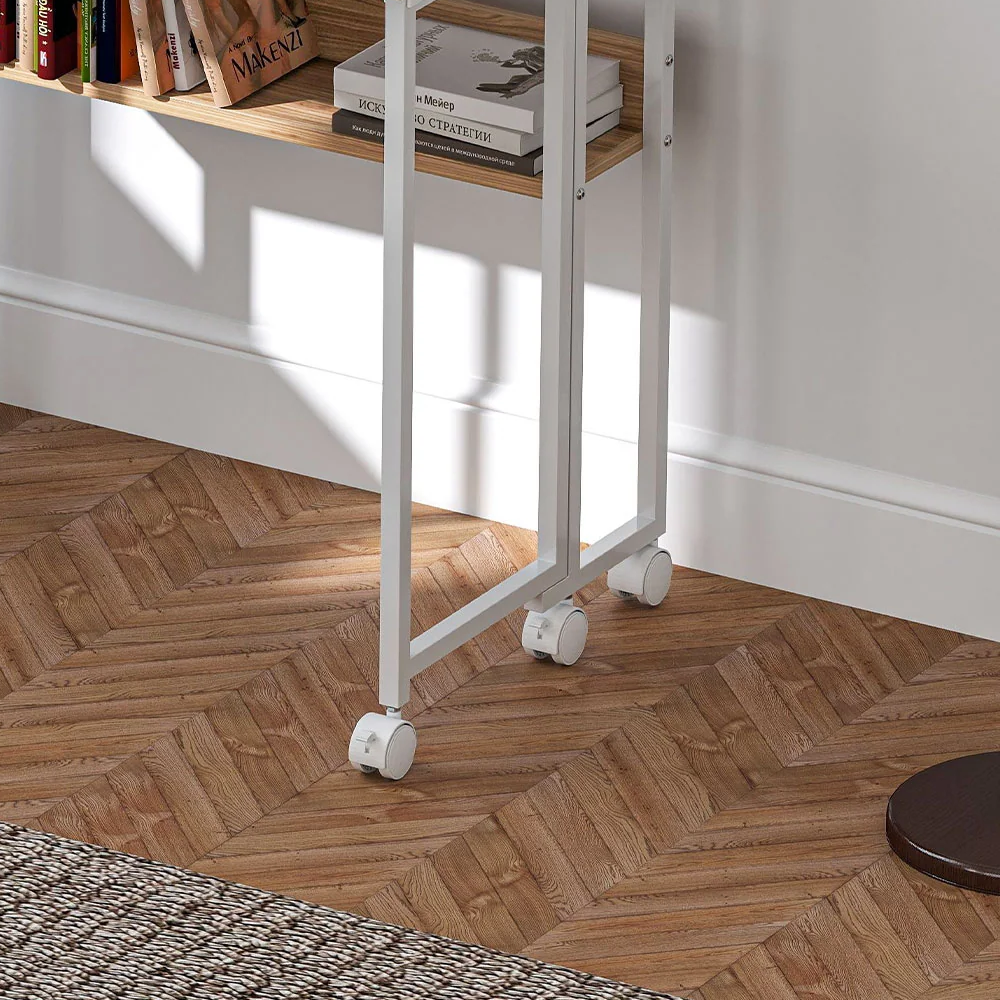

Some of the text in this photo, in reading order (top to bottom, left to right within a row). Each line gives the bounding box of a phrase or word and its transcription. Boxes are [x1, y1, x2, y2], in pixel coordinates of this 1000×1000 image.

[39, 20, 52, 37] HÓI
[168, 33, 180, 70] Makenzi
[230, 29, 303, 82] MAKENZI
[424, 95, 455, 112] Мейер
[428, 116, 491, 143] СТРАТЕГИИ
